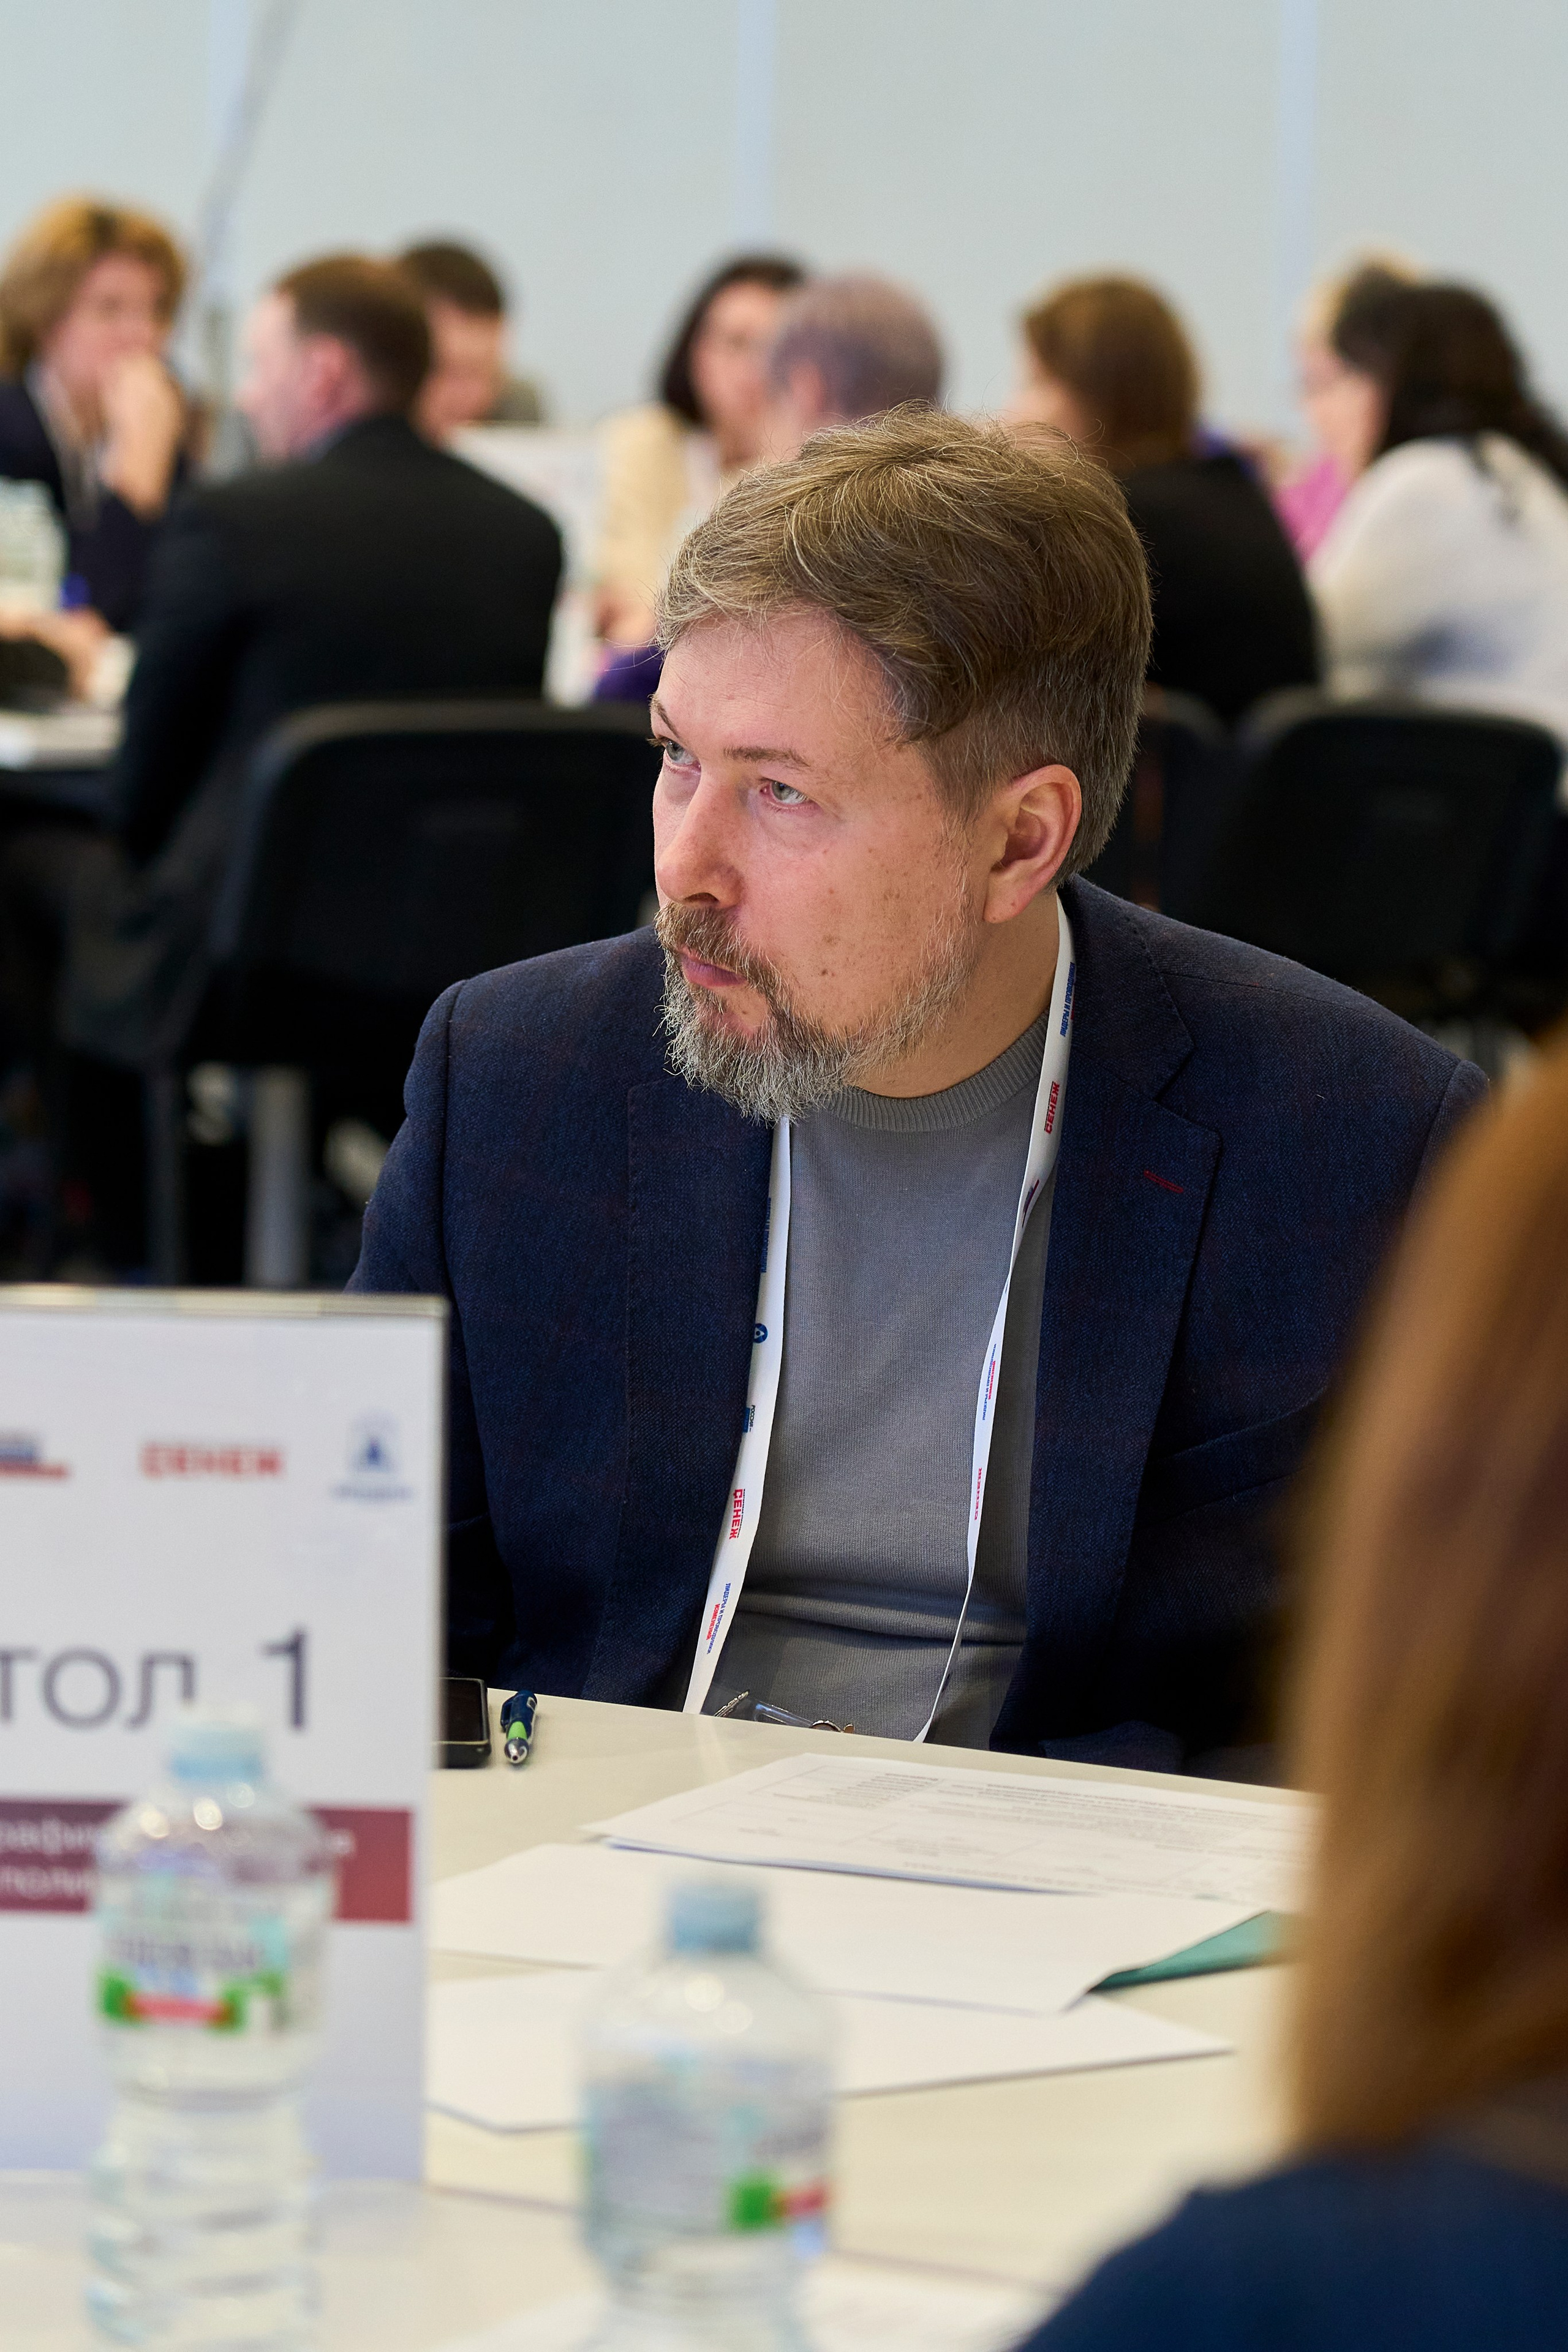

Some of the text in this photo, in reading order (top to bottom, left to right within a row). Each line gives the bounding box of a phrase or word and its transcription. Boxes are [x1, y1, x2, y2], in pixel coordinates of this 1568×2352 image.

[1060, 1009, 1069, 1037] ЛИДЕРЫ
[1045, 1082, 1060, 1134] СЕНЕЖ
[729, 1488, 743, 1540] СЕНЕЖ
[721, 1583, 731, 1608] ЛИДЕРЫ
[706, 1604, 720, 1640] ИЗМЕНЕНИЙ
[262, 1626, 309, 1732] 1
